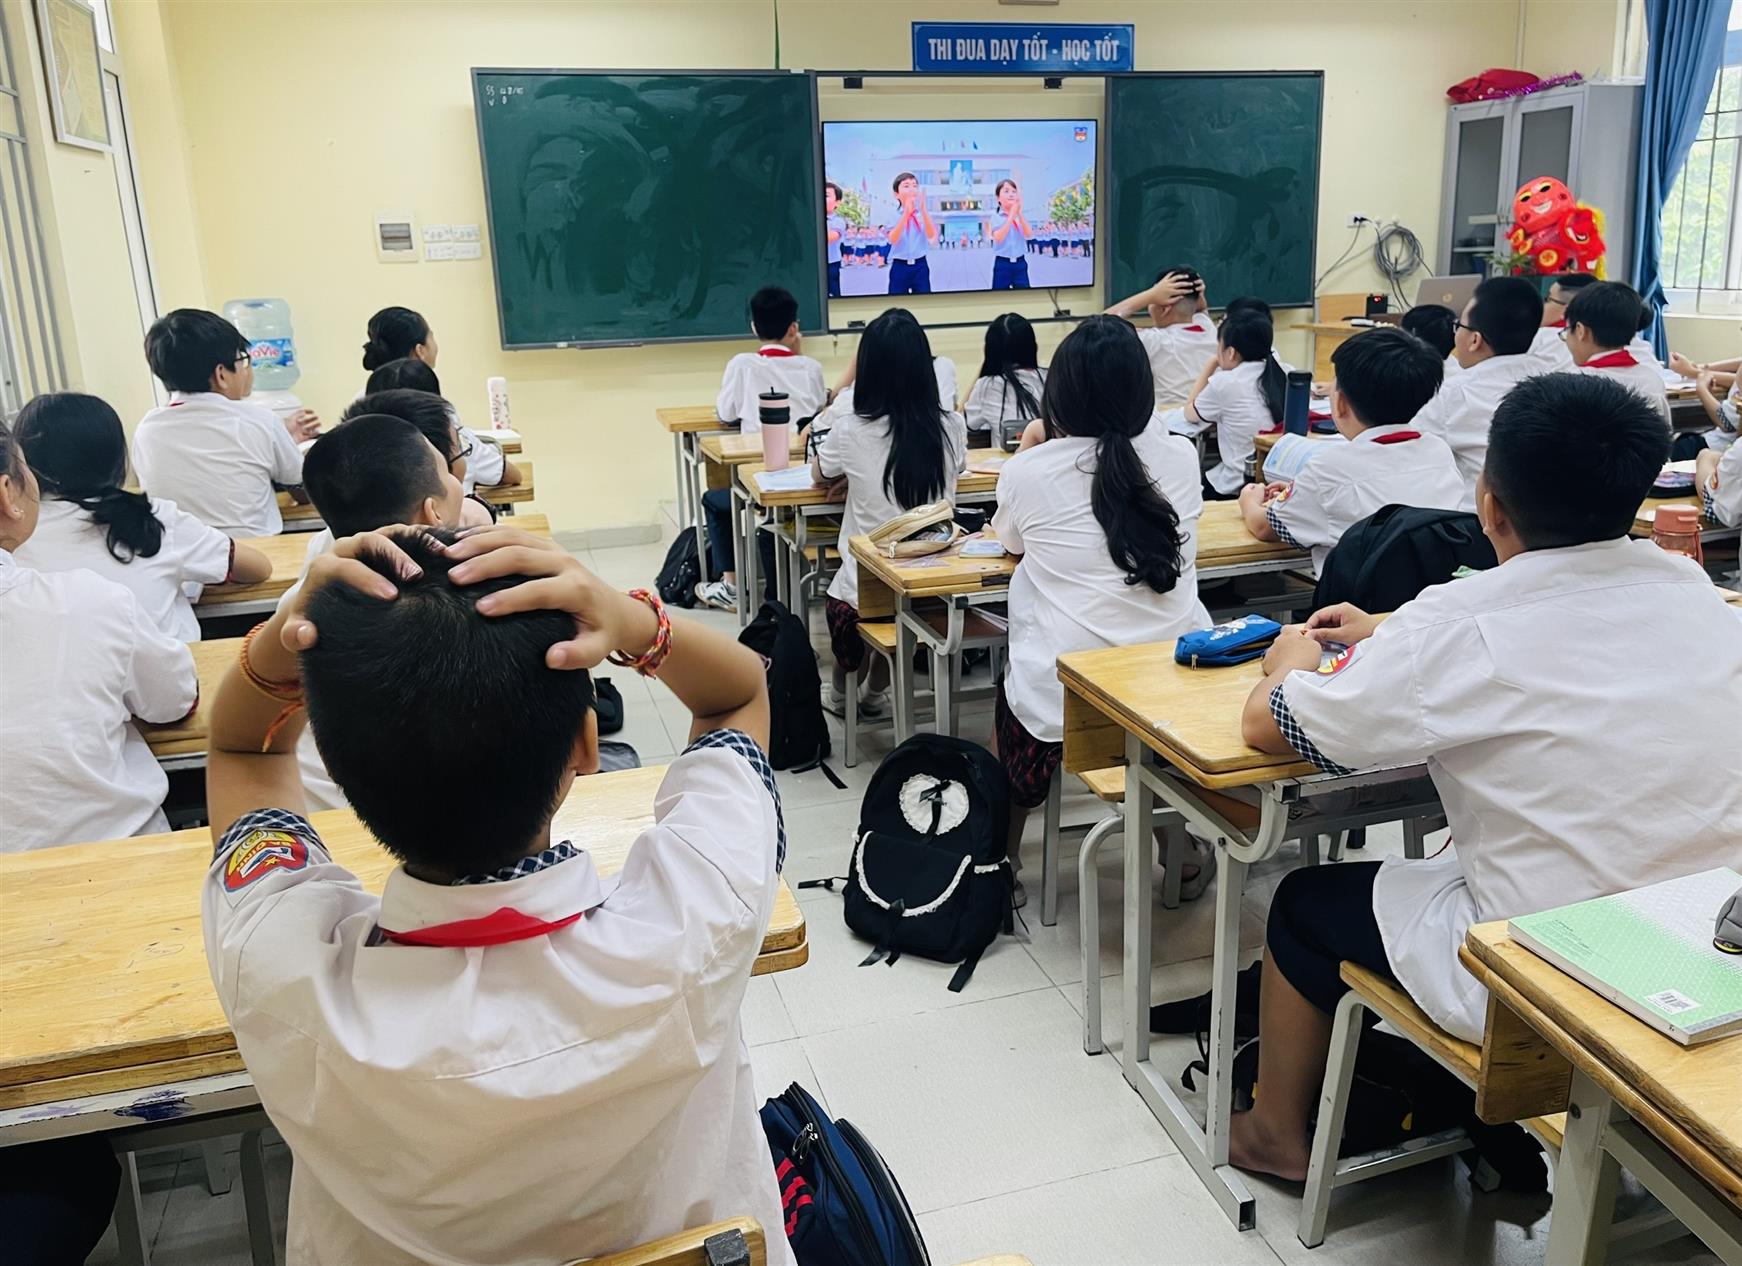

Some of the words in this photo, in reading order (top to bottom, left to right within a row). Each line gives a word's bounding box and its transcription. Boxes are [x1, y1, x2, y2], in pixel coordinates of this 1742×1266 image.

[928, 38, 952, 61] THI
[956, 38, 986, 61] ĐUA
[990, 39, 1019, 66] DẠY
[1022, 32, 1048, 61] TỐT
[1062, 39, 1090, 66] HỌC
[1094, 32, 1120, 61] TỐT
[250, 345, 280, 358] aVie
